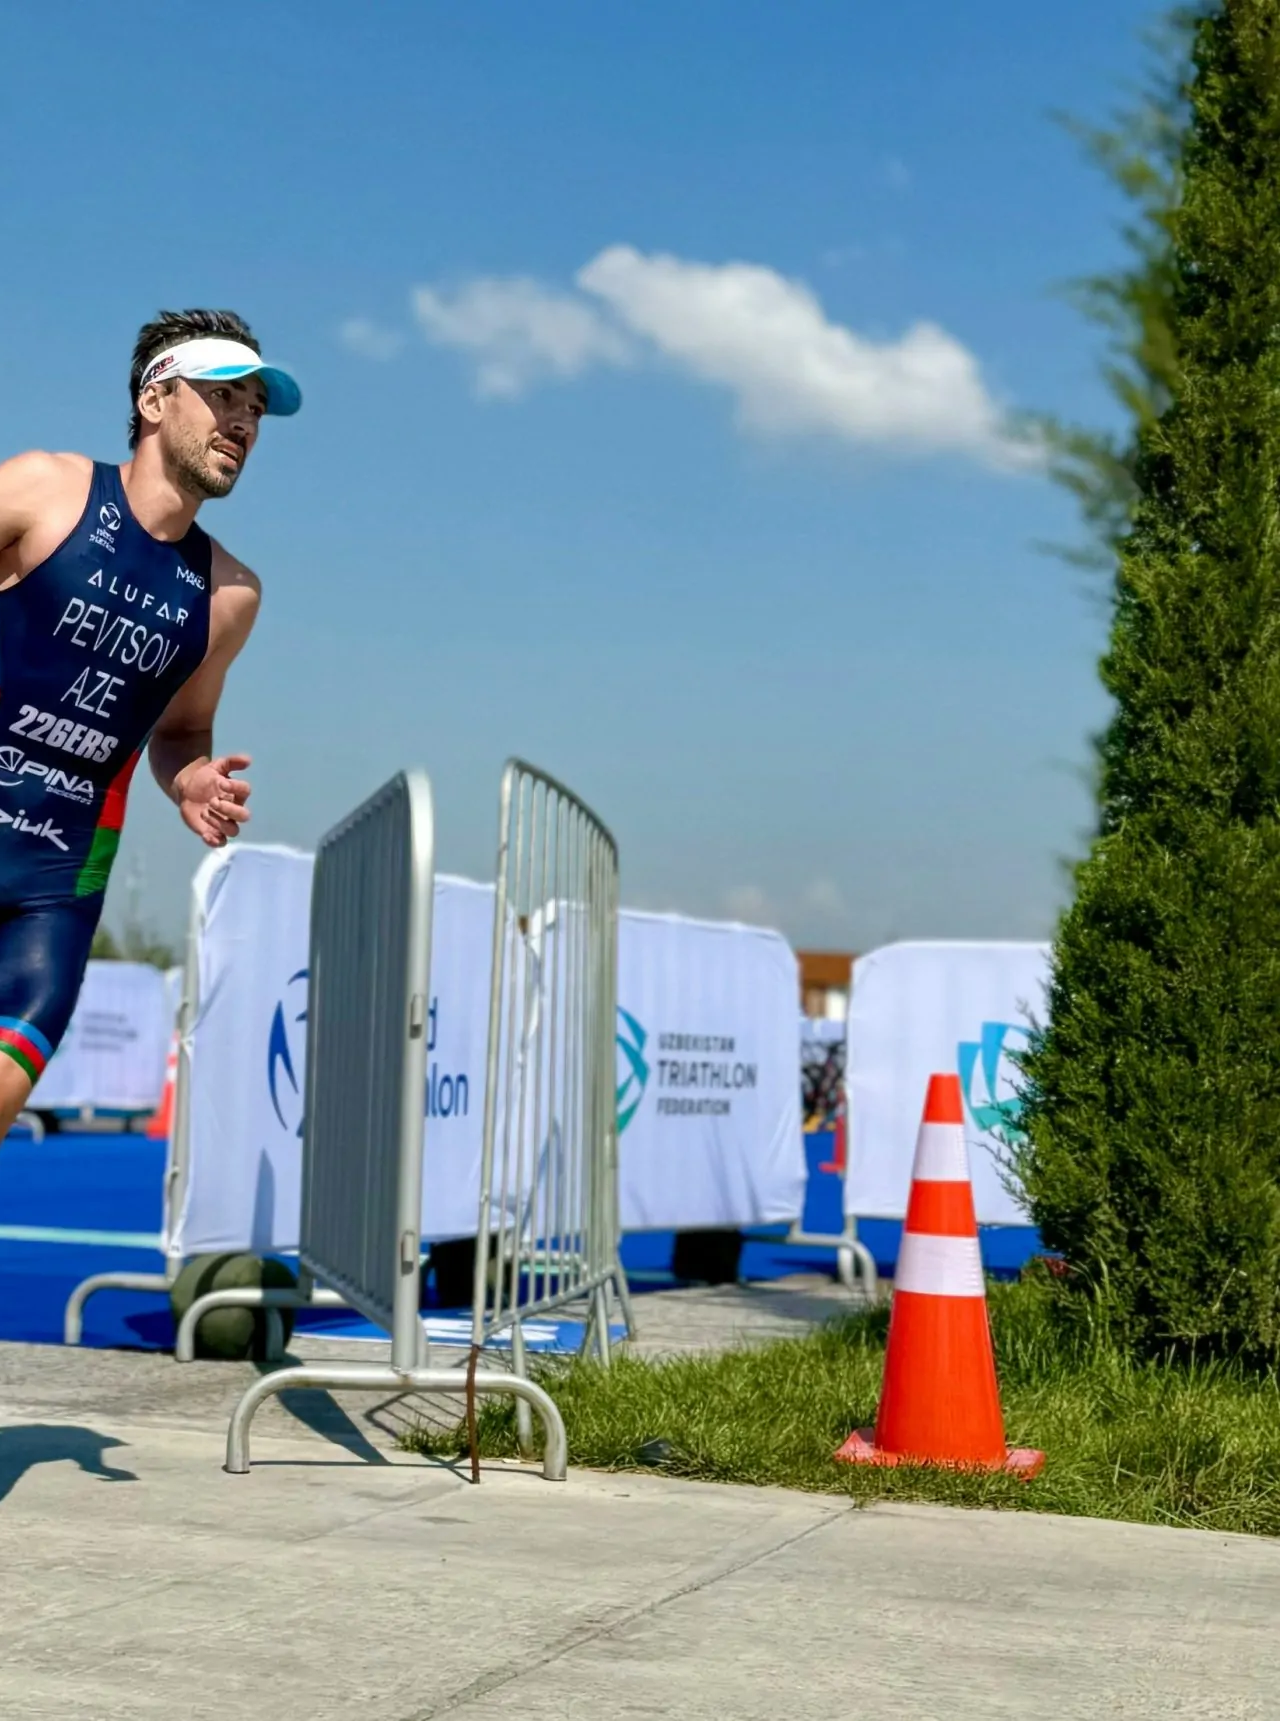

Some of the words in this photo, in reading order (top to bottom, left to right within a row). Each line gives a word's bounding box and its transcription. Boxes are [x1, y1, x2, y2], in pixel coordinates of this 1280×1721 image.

[87, 568, 190, 628] ALUFAR
[53, 596, 180, 679] PEVTSOV
[60, 665, 126, 719] AZE
[8, 703, 120, 764] 226ERS
[658, 1033, 735, 1052] UZBEKISTAN
[656, 1059, 758, 1090] TRIATHLON
[656, 1097, 731, 1117] FEDERATION
